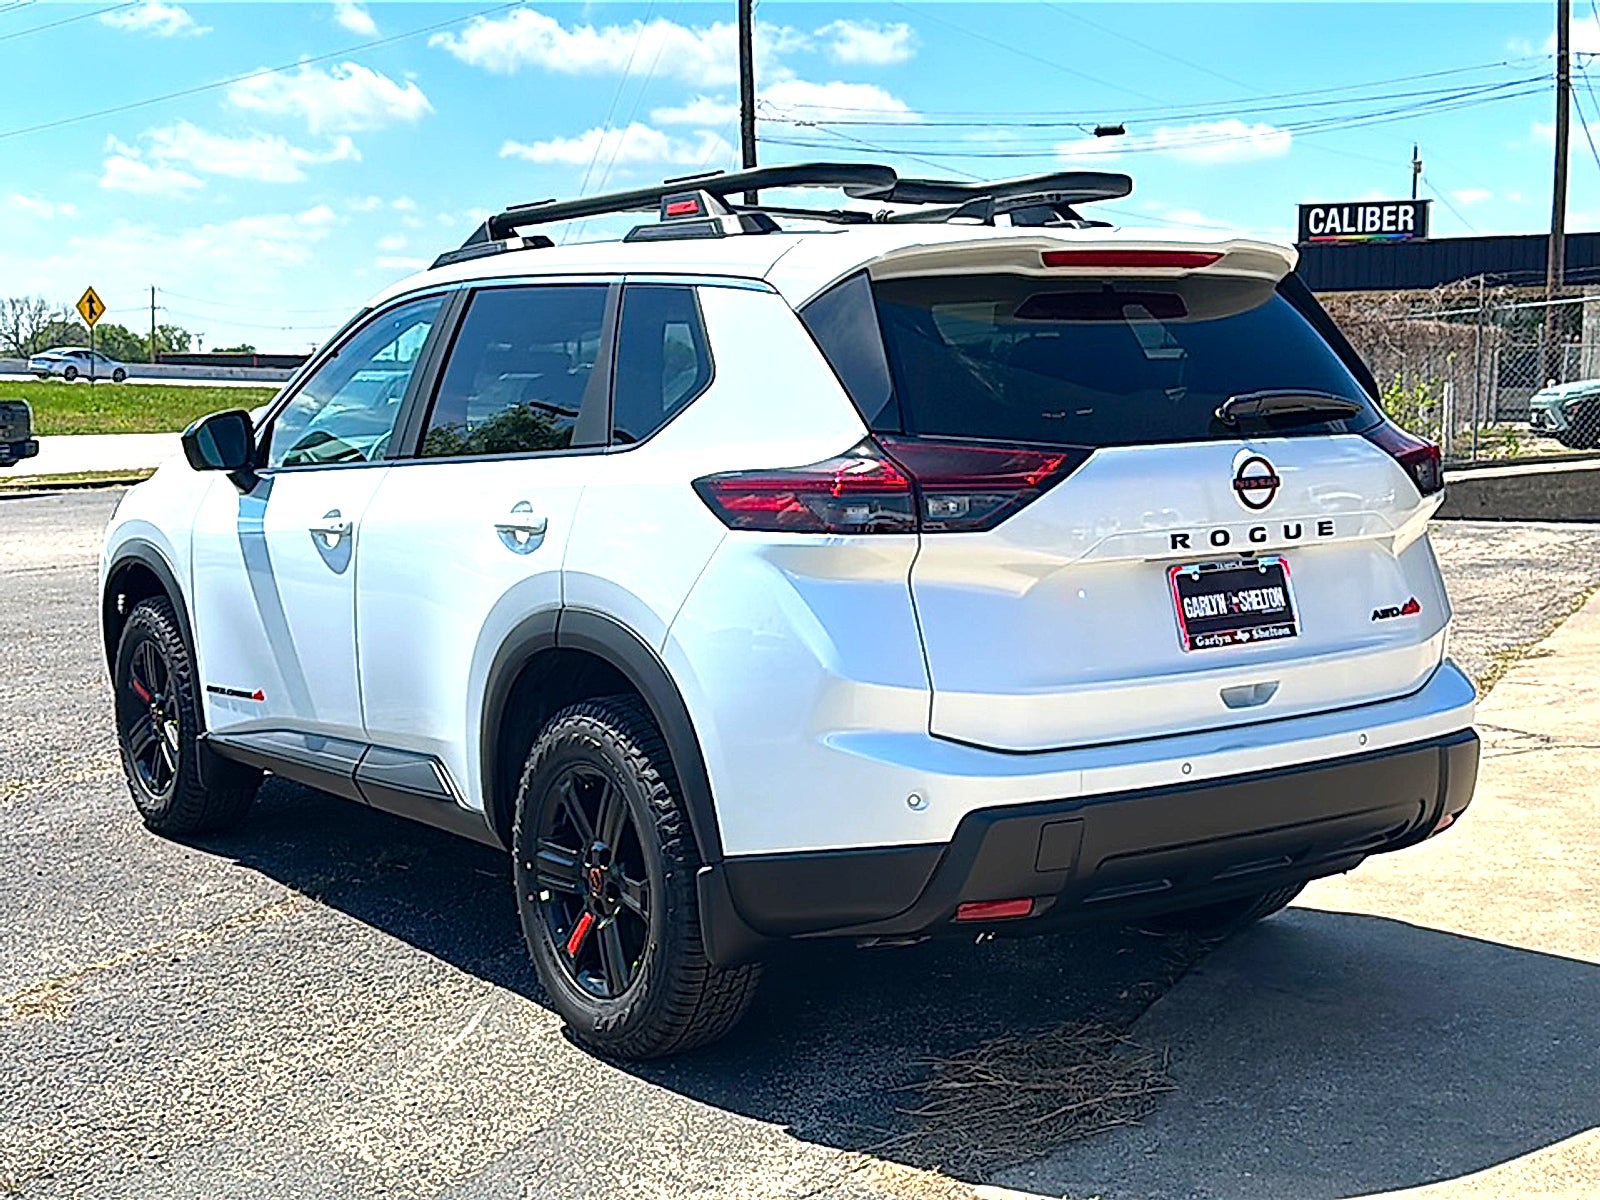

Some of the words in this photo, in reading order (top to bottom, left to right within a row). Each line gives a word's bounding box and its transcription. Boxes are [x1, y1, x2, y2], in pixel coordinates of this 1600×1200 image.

[1309, 205, 1414, 234] CALIBER
[1170, 521, 1334, 549] ROGUE
[1183, 593, 1228, 618] GARLYN
[1238, 587, 1286, 612] SHELTON
[1196, 634, 1232, 646] Garlyn
[1252, 627, 1291, 639] Shelton
